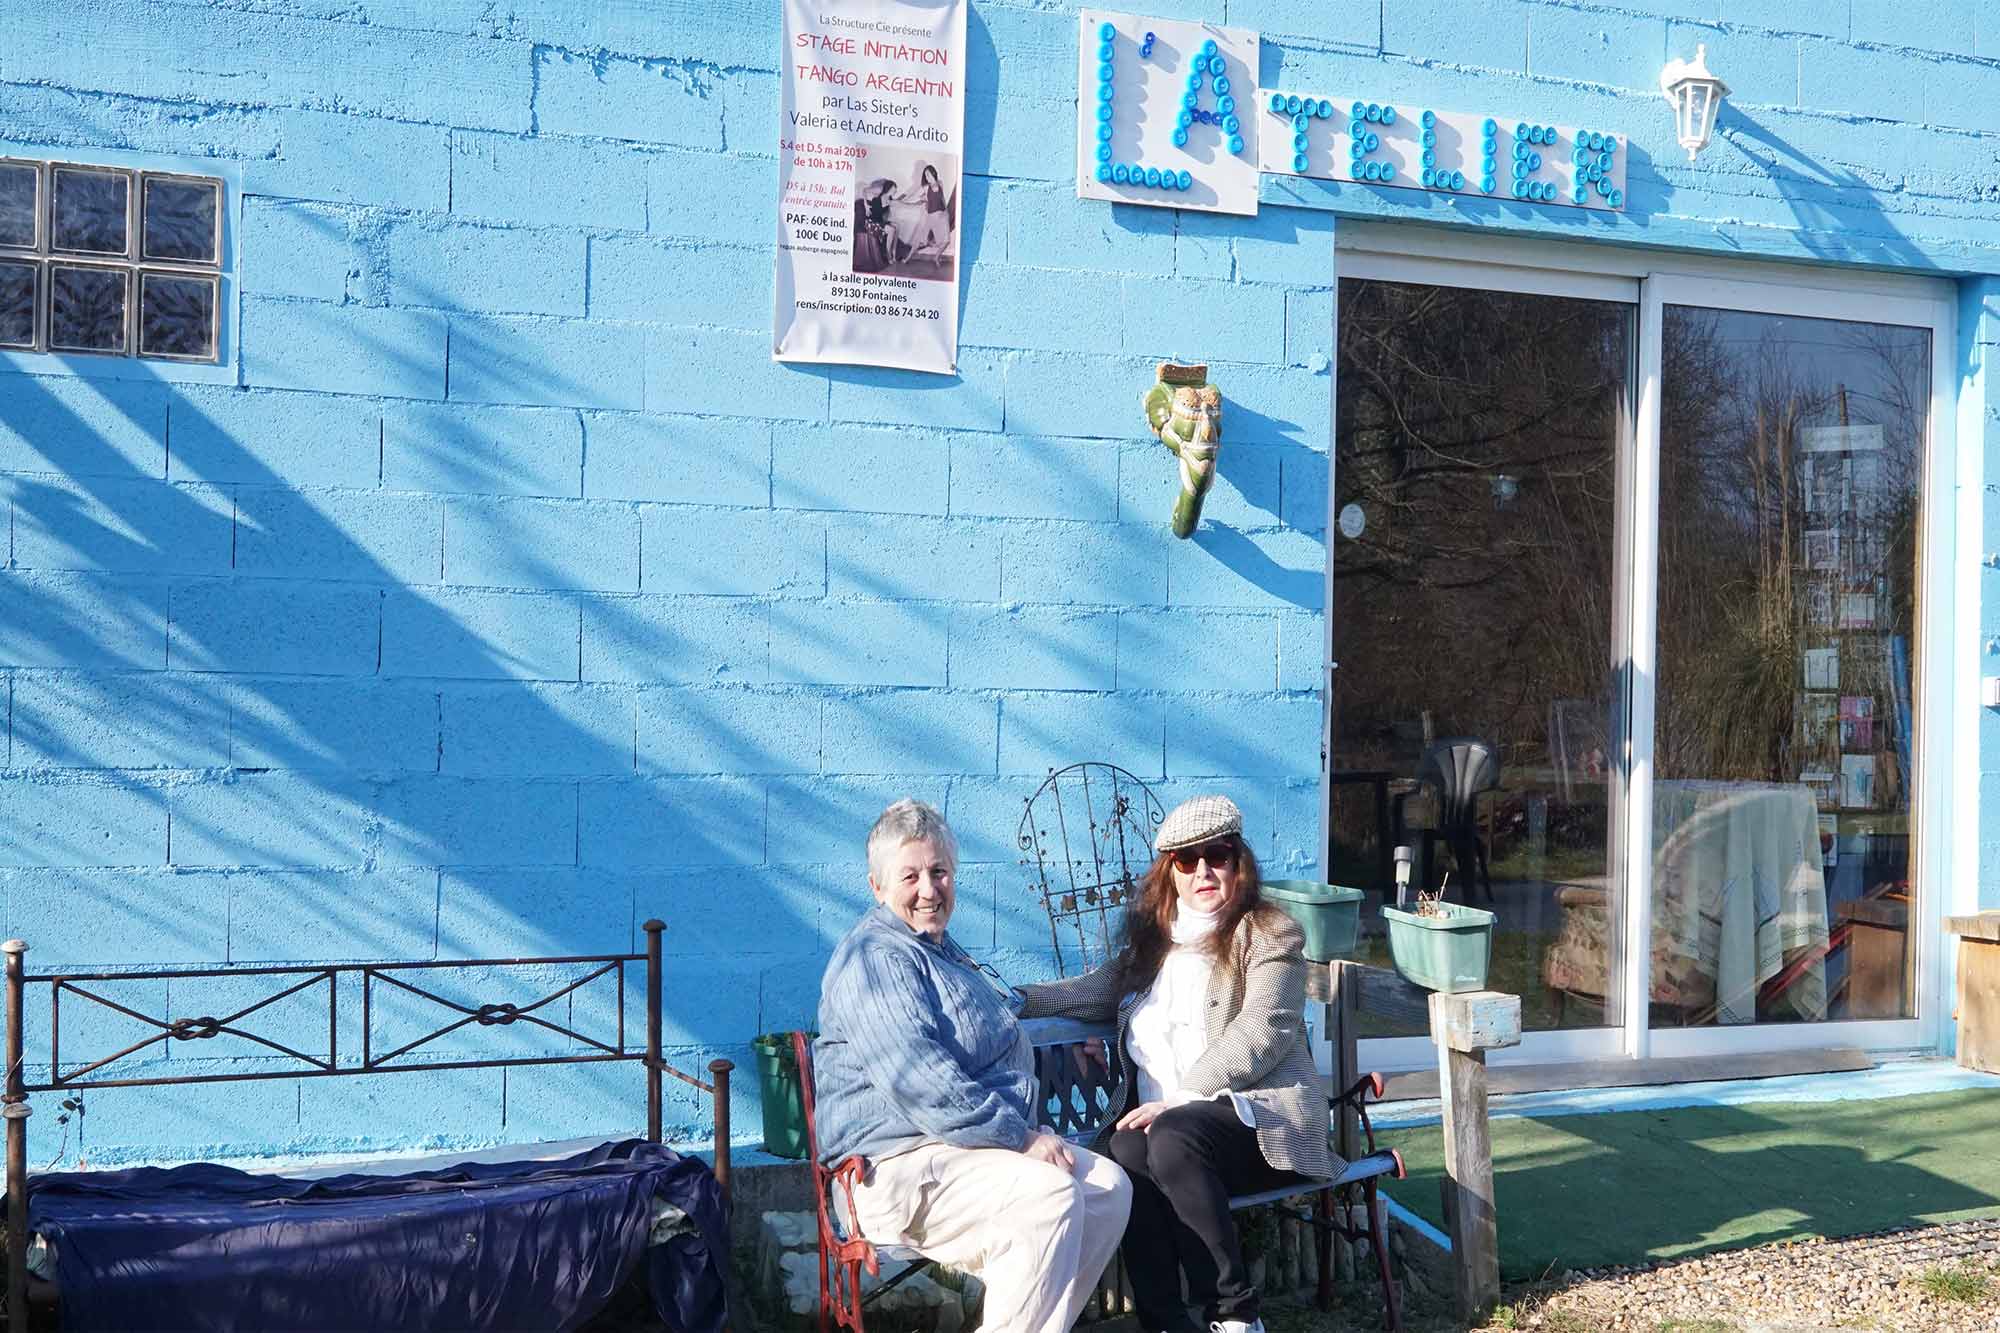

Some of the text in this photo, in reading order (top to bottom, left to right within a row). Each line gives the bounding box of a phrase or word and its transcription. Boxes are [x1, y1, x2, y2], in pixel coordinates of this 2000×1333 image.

[819, 15, 932, 38] La Structure Cie présente
[796, 33, 948, 66] STAGE INITIATION
[797, 65, 952, 98] TANGO ARGENTIN
[822, 95, 918, 118] par Las Sister's
[790, 111, 949, 143] Valeria et Andrea Ardito
[795, 143, 804, 152] et
[807, 143, 823, 153] D.5
[825, 145, 842, 156] mai
[844, 147, 867, 158] 2019
[794, 156, 852, 171] de 10h à 17h
[786, 213, 847, 229] PAF: 60€ ind.
[796, 229, 842, 243] 100€ Duo
[822, 271, 917, 290] à la salle polyvalente
[831, 287, 907, 303] 89130 Fontaines
[796, 300, 939, 320] rens/inscription: 03 86 74 34 20
